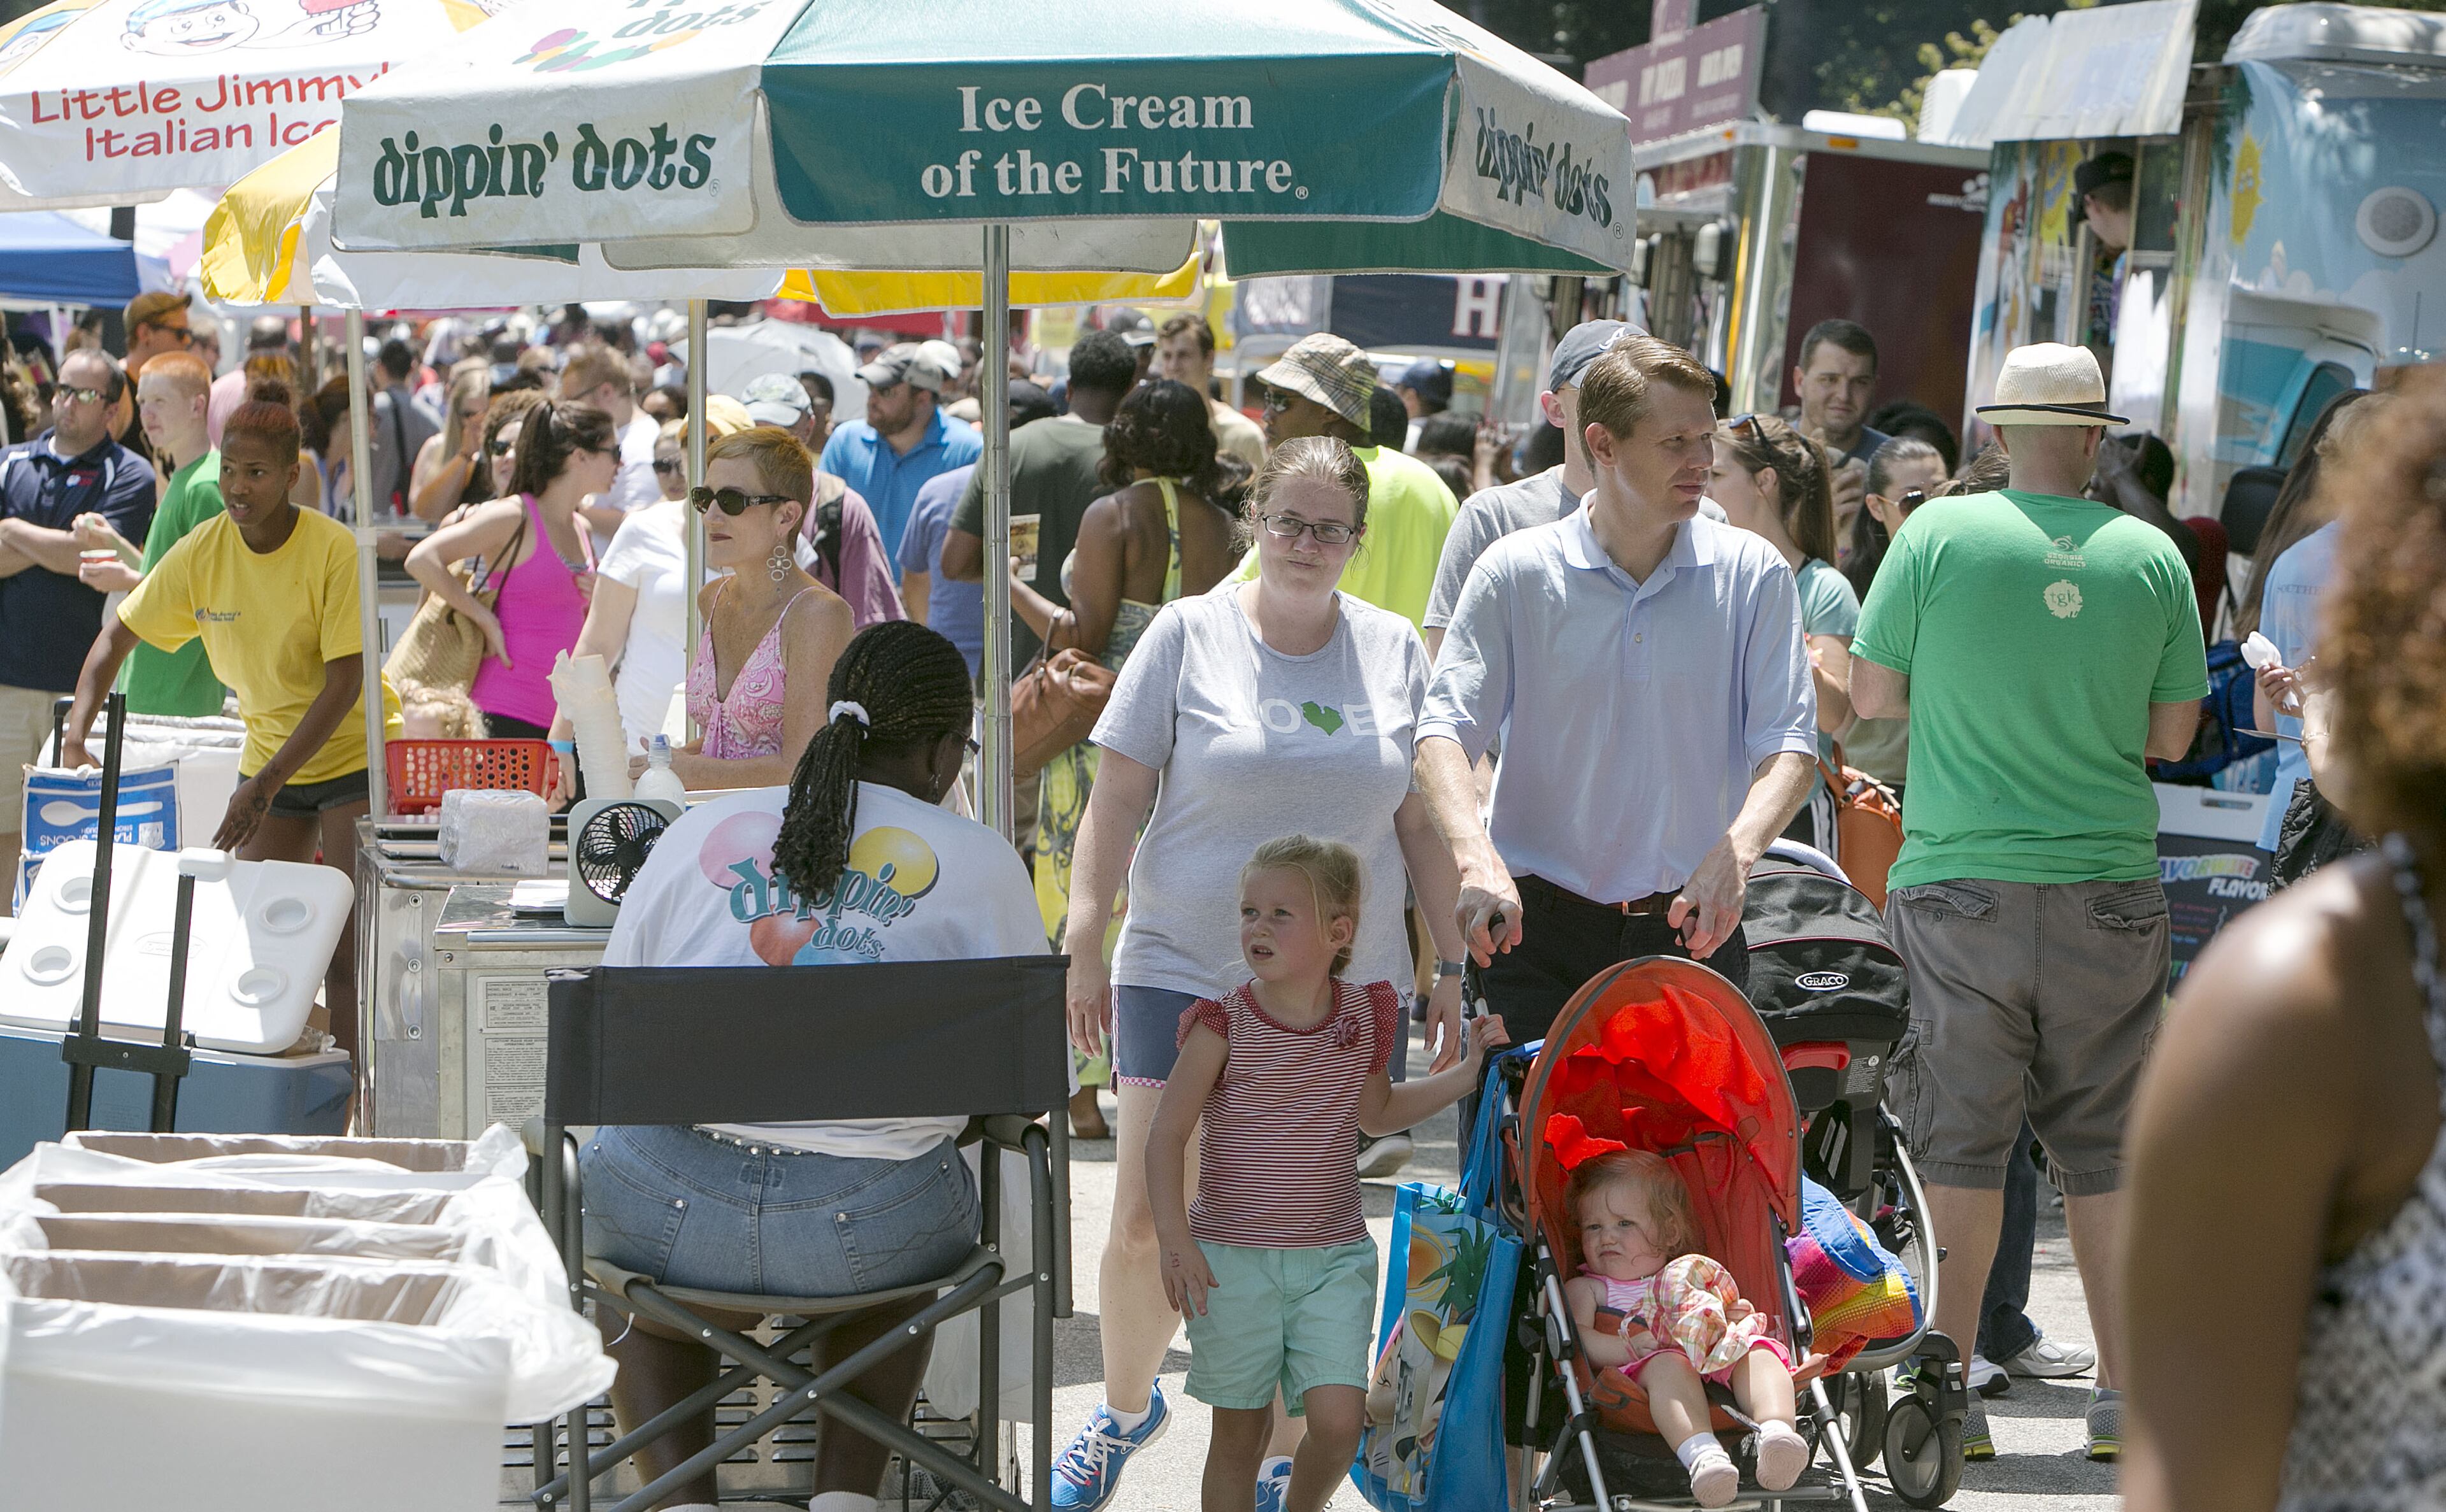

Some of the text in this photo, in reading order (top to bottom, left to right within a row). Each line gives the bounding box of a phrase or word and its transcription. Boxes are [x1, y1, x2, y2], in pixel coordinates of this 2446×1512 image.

[32, 81, 182, 124] Little
[957, 83, 1254, 132] Ice Cream
[86, 119, 253, 162] Italian
[373, 122, 717, 218] dippin' dots
[921, 148, 1293, 197] of the Future
[1476, 106, 1554, 207] dippin'
[1555, 142, 1613, 229] dots
[2044, 558, 2087, 567] ORGANICS
[2047, 552, 2084, 561] GEORGIA
[2050, 589, 2077, 608] tgk
[810, 918, 885, 958] dots
[1803, 976, 1844, 987] GRACO
